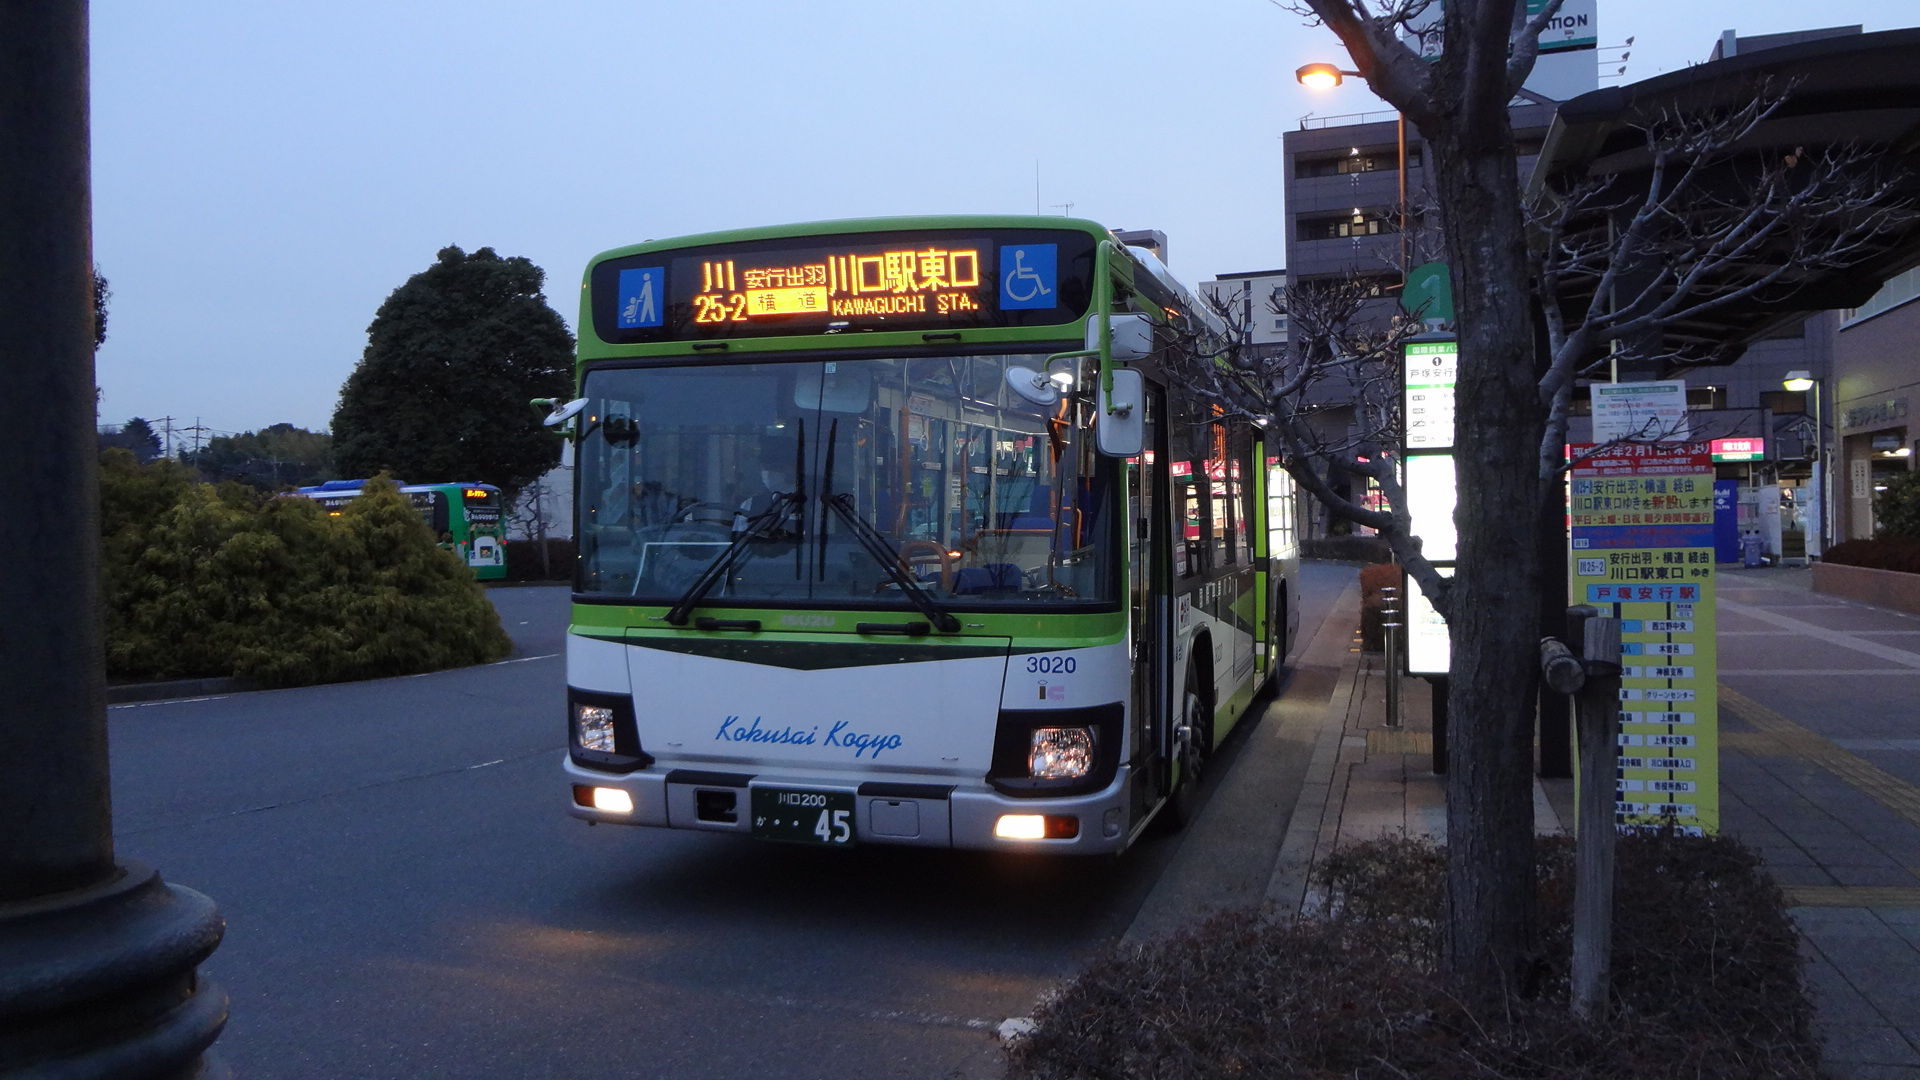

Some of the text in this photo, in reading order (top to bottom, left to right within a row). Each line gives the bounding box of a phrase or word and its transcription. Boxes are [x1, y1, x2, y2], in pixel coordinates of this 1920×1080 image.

[703, 260, 736, 293] 川
[743, 264, 828, 289] 安行出羽
[827, 247, 979, 297] 川口駅東口
[693, 292, 748, 323] 25-2
[832, 295, 926, 317] KAWAGUCHI
[1611, 567, 1710, 580] 川口駅東口 ゆき
[1597, 587, 1695, 600] 戸塚安行駅
[1026, 656, 1077, 674] 3020
[715, 716, 902, 759] Kokusai Kogyo
[815, 809, 851, 843] 45
